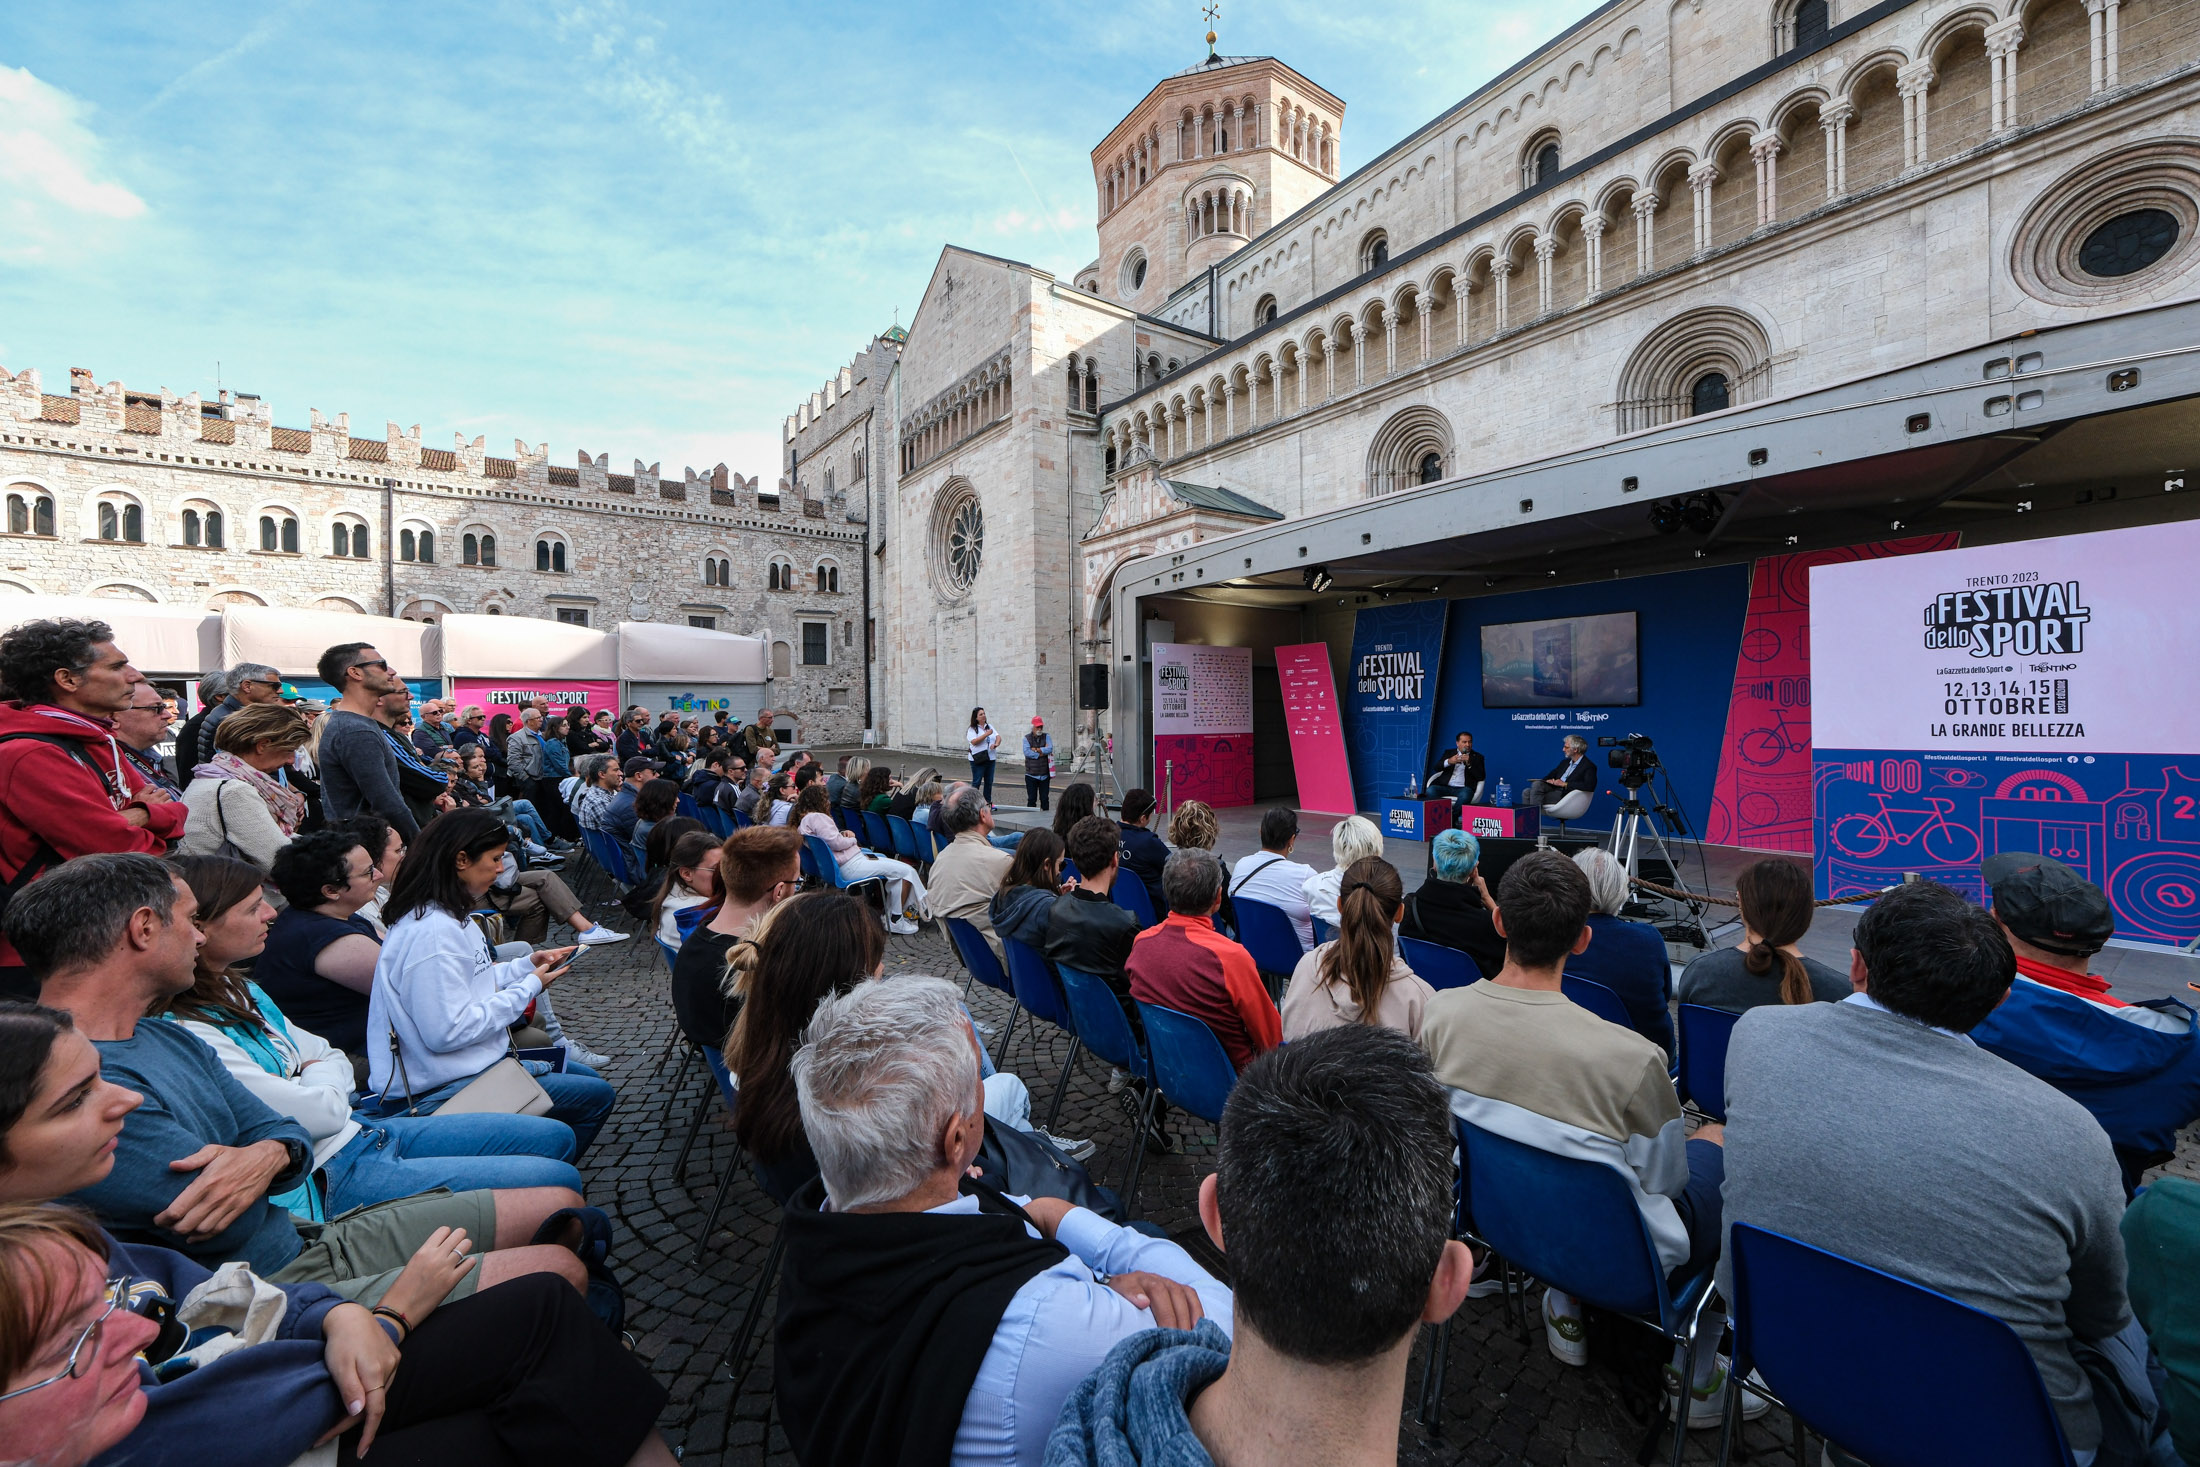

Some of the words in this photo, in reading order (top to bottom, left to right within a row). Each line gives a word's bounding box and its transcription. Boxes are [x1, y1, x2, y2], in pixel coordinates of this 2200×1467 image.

[1966, 574, 2008, 588] TRENTO
[2012, 572, 2039, 583] 2023
[1924, 604, 1936, 626] il
[1938, 581, 2090, 624] FESTIVAL
[1926, 626, 1970, 648] dello
[1970, 616, 2090, 657] SPORT
[1358, 662, 1363, 676] il
[1363, 652, 1424, 676] FESTIVAL
[1986, 666, 2003, 674] Sport
[2029, 662, 2076, 673] TRENTINO
[1161, 666, 1189, 678] FESTIVAL
[1168, 678, 1189, 690] SPORT
[1358, 678, 1376, 693] dello
[1377, 674, 1424, 700] SPORT
[1751, 681, 1774, 701] RUN
[1944, 682, 1963, 696] 12
[1972, 682, 1991, 696] 13
[2000, 680, 2020, 696] 14
[2029, 680, 2050, 695] 15
[556, 691, 589, 705] SPORT
[668, 696, 730, 712] TRENTINO
[1944, 697, 2050, 715] OTTOBRE
[1546, 712, 1559, 721] Sport
[1576, 711, 1609, 722] TRENTINO
[1931, 724, 1947, 737] LA
[1952, 723, 2006, 737] GRANDE
[2012, 723, 2085, 737] BELLEZZA
[152, 742, 176, 757] VAN
[124, 752, 138, 762] 70D
[136, 761, 153, 775] EOS
[1846, 760, 1874, 784] RUN
[1880, 758, 1922, 794] 00
[1391, 809, 1414, 820] FESTIVAL
[2173, 795, 2200, 820] 2
[1396, 818, 1414, 829] SPORT
[1475, 817, 1502, 828] FESTIVAL
[1481, 828, 1502, 837] SPORT
